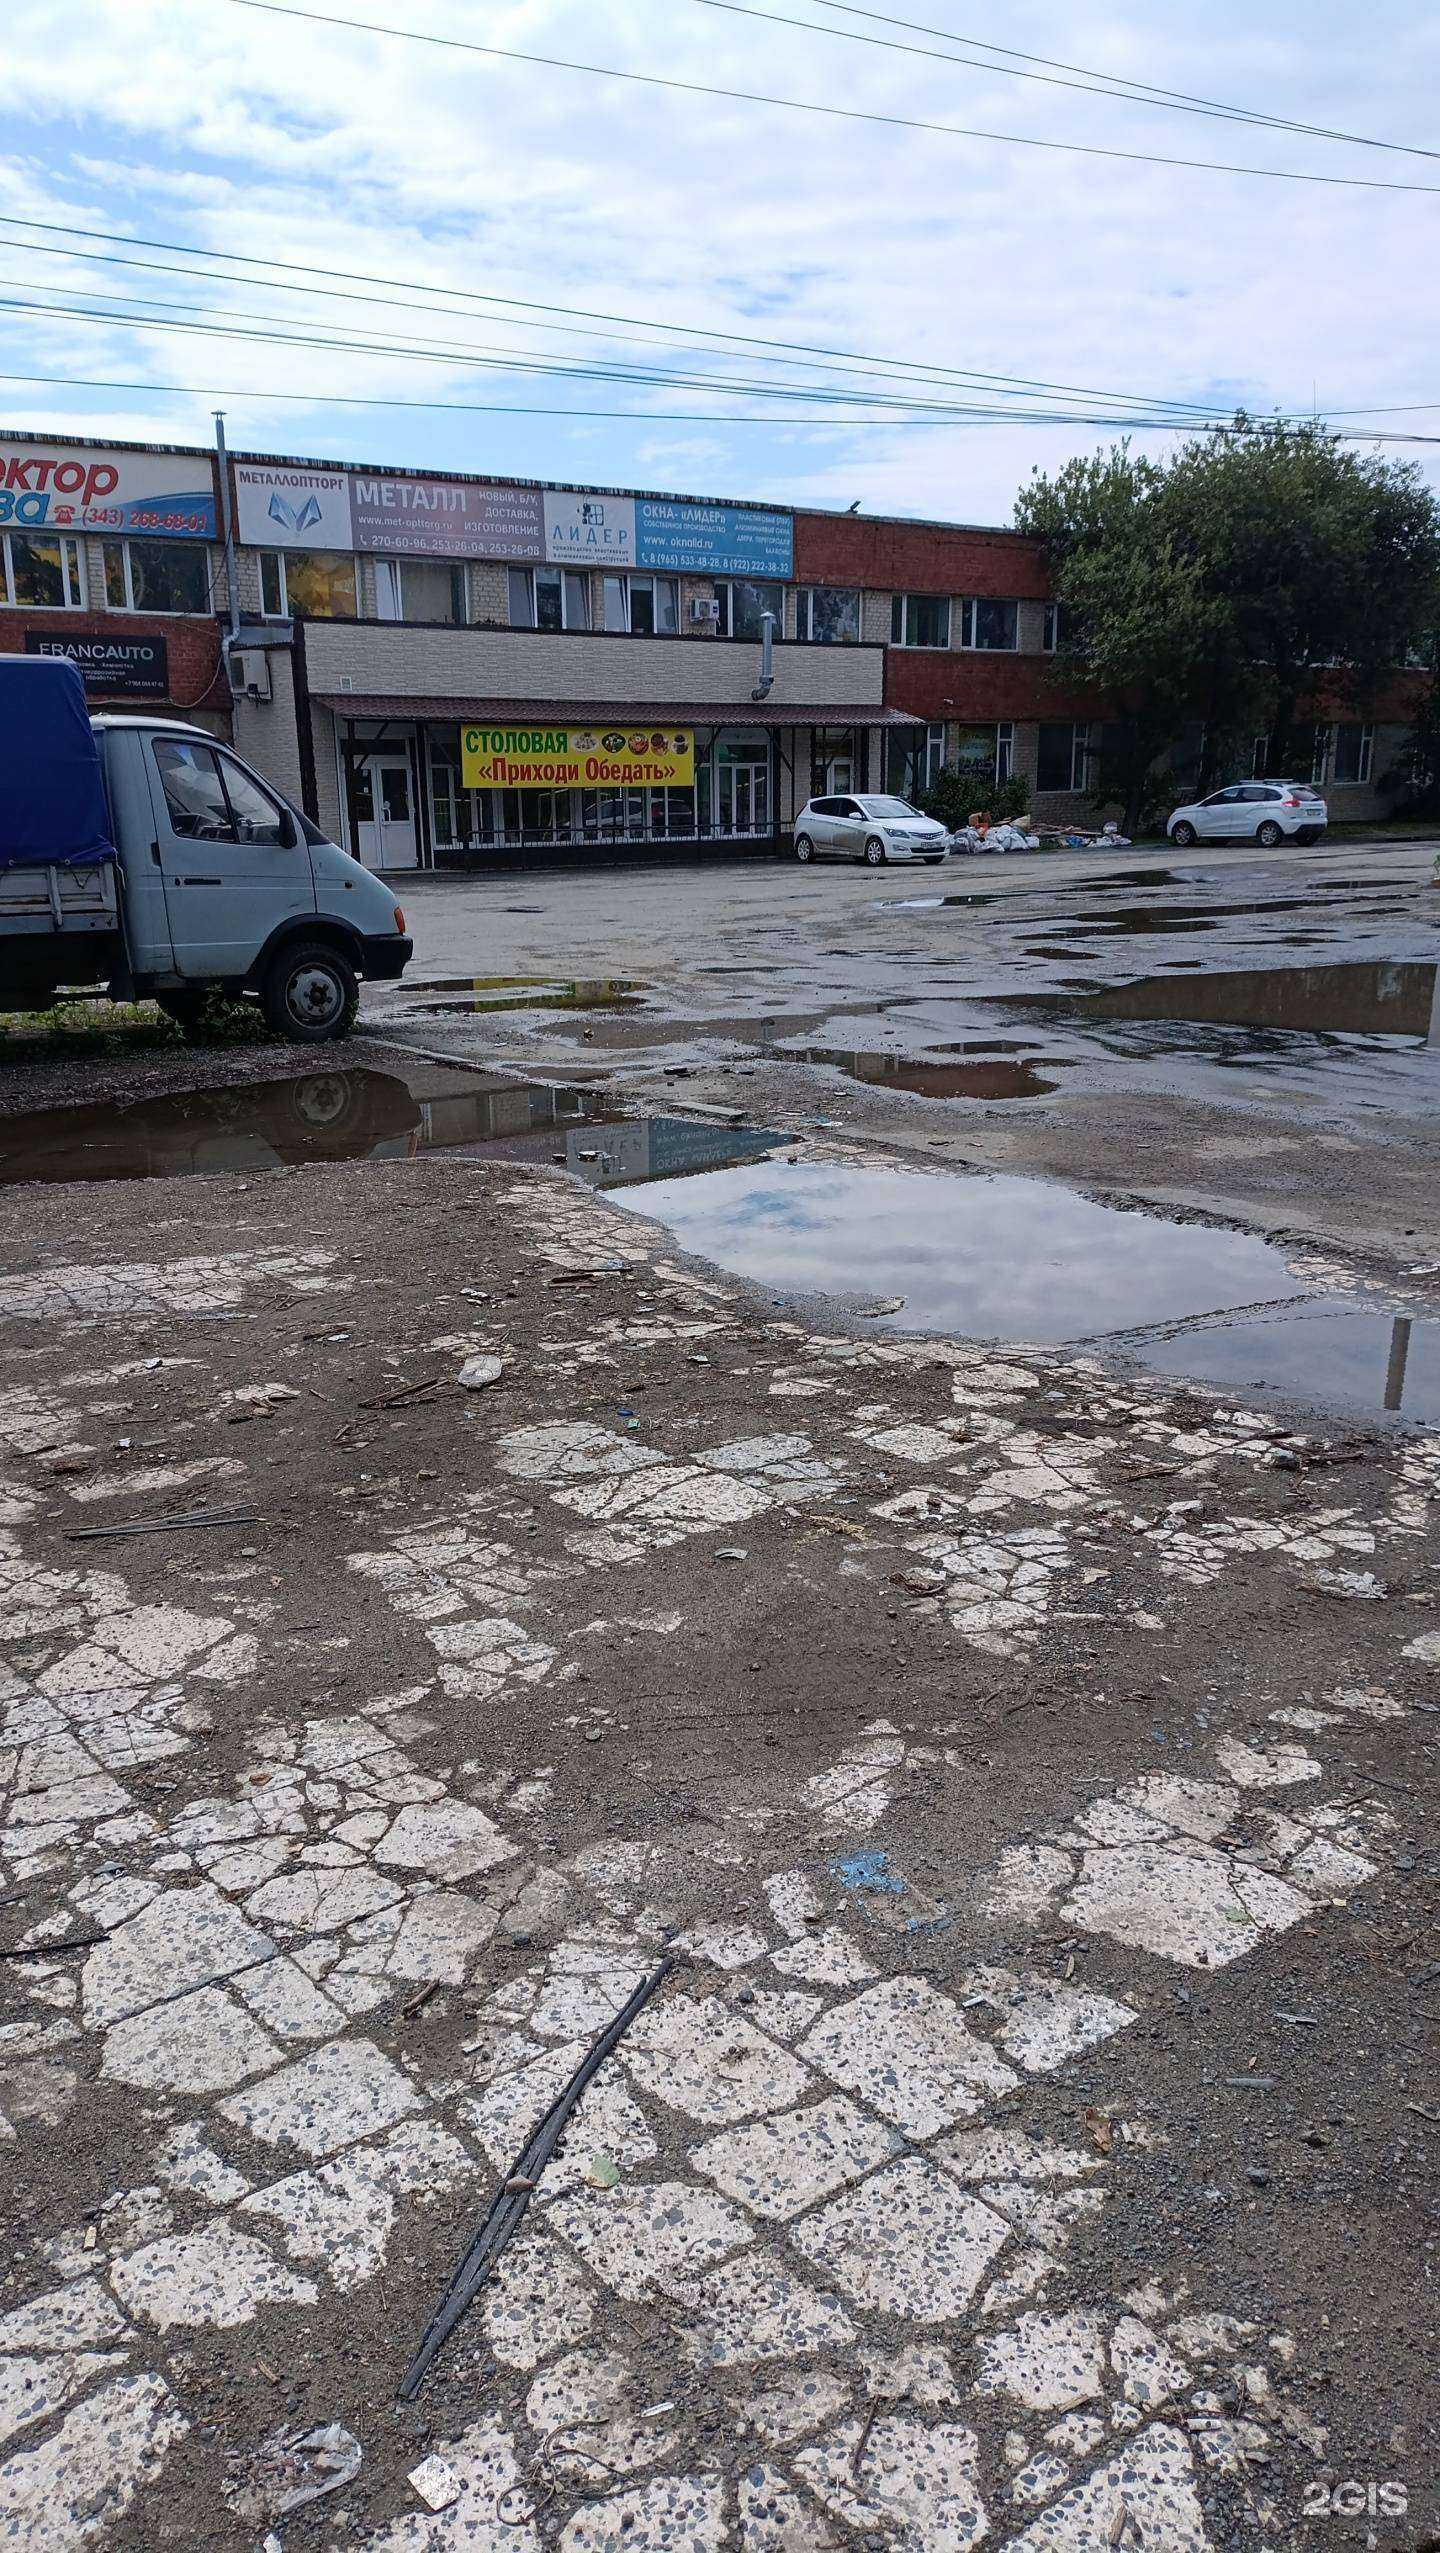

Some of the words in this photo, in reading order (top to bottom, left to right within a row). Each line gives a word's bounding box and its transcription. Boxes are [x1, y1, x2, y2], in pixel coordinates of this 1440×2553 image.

[0, 456, 119, 506] ктор
[239, 470, 344, 490] МЕТАЛЛОПТТОРГ
[356, 480, 468, 513] МЕТАЛЛ
[479, 490, 518, 505] НОВЫЙ,
[519, 493, 538, 506] Б/У,
[82, 507, 125, 528] (343)
[358, 515, 453, 531] www.met-opttorg.ru
[484, 506, 539, 521] ДОСТАВКА,
[681, 509, 726, 525] «ЛИДЕР»
[464, 520, 540, 536] ИЗГОТОВЛЕНИЕ
[552, 524, 628, 545] ЛИДЕР
[39, 642, 154, 660] FRANCAUTO
[465, 730, 568, 754] СТОЛОВАЯ
[478, 757, 579, 785] «Приходи
[585, 757, 676, 785] Обедать»
